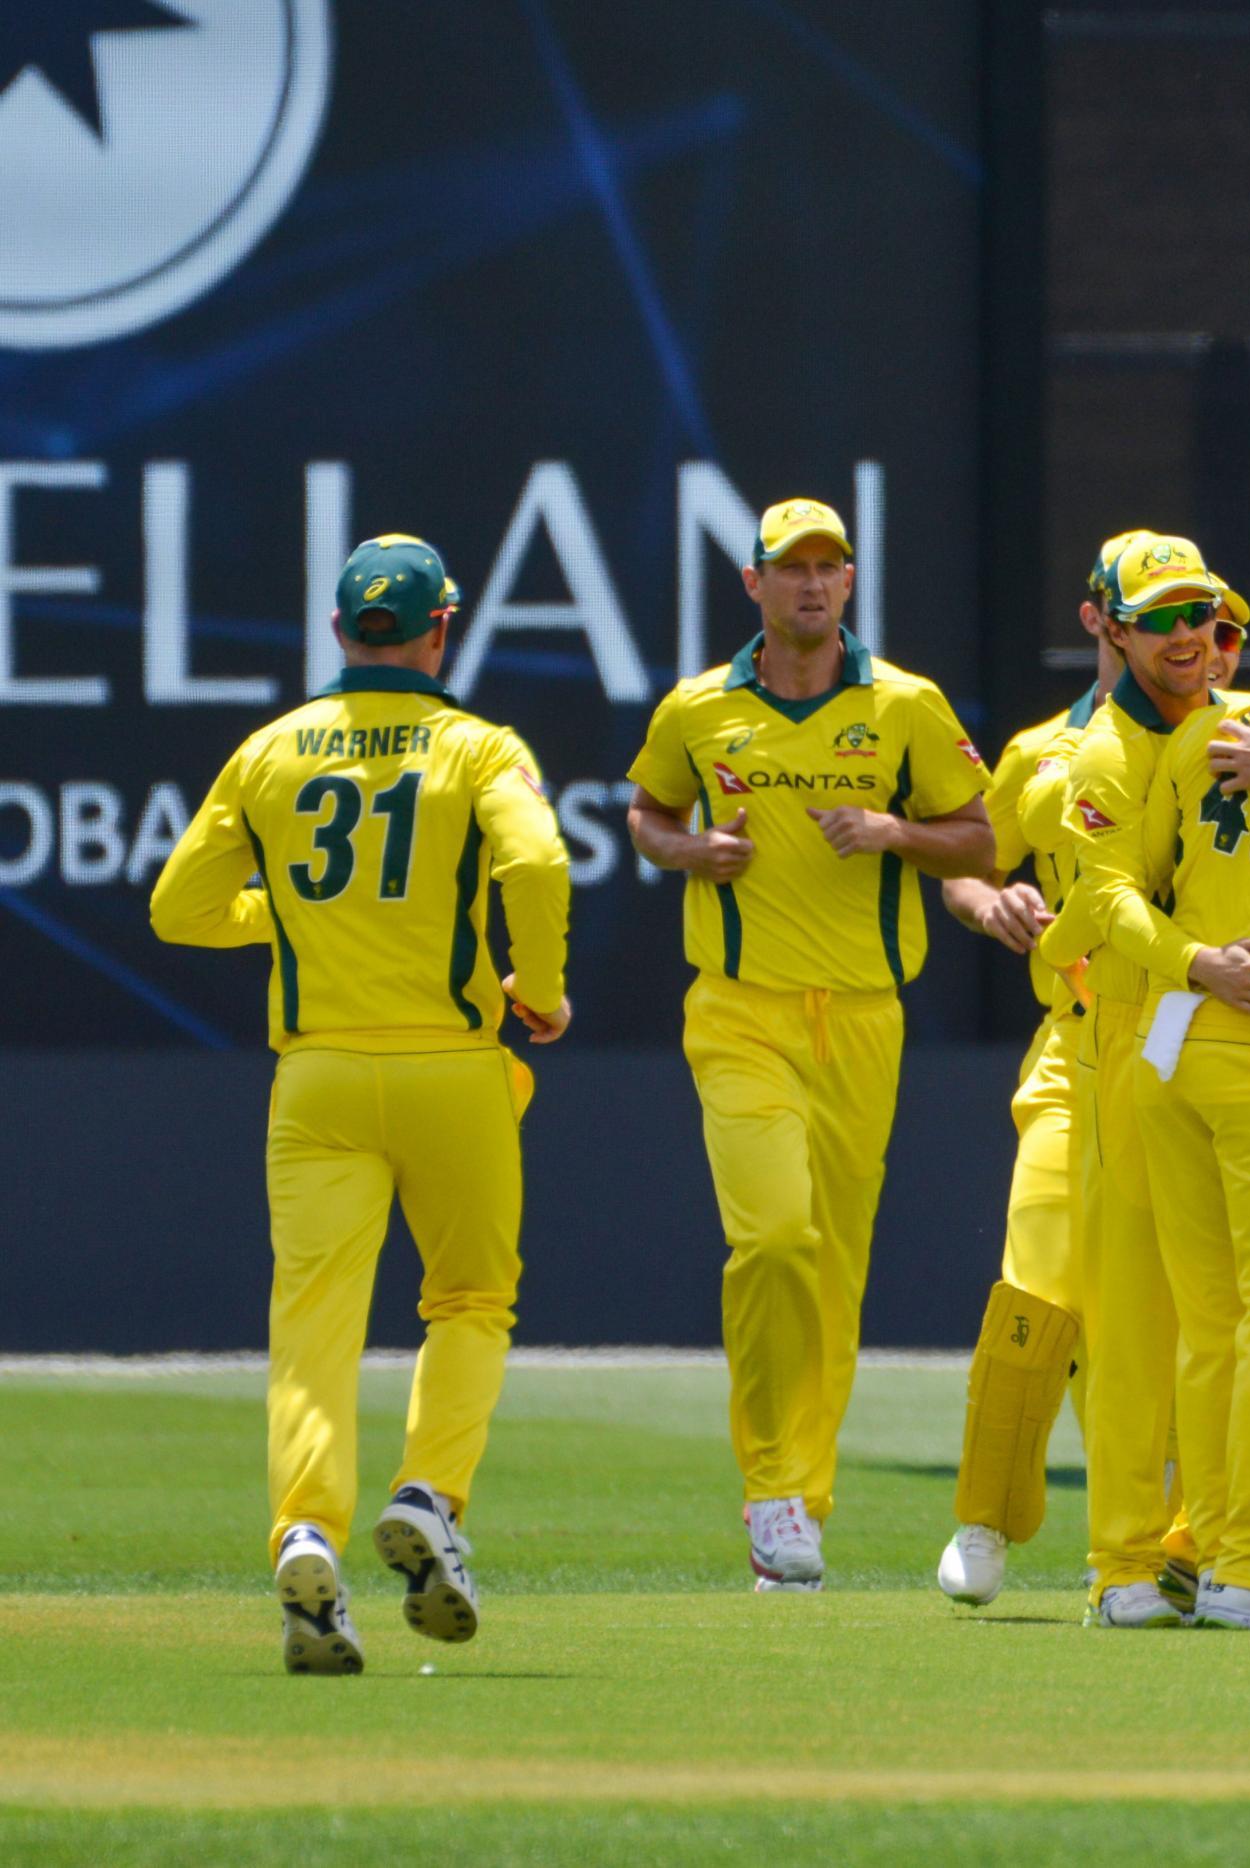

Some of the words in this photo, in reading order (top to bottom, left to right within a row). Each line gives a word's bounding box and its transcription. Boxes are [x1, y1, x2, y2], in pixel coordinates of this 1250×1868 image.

[296, 725, 431, 759] WARNER
[747, 770, 877, 791] QANTAS
[288, 769, 425, 903] 31
